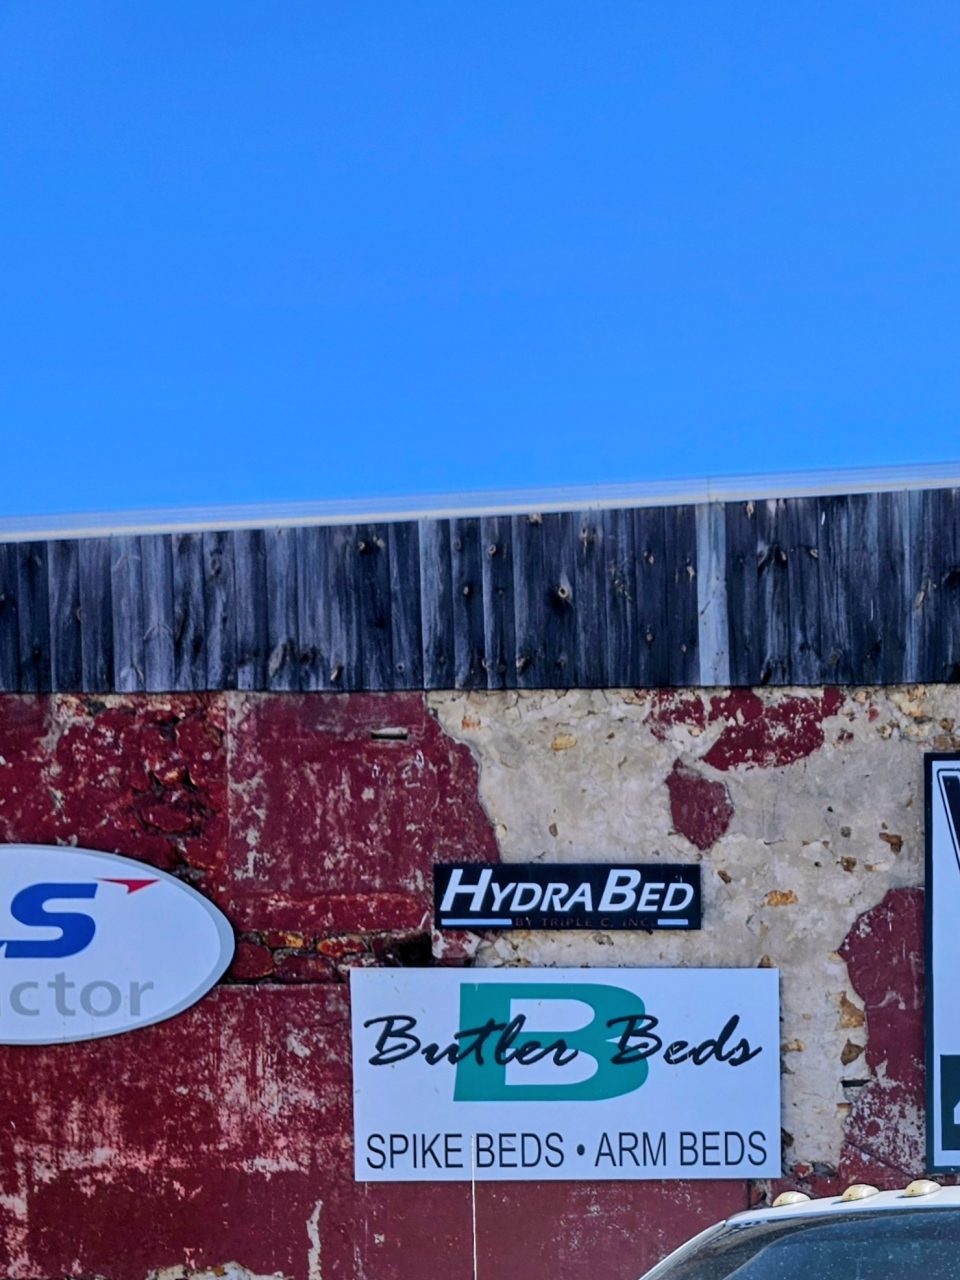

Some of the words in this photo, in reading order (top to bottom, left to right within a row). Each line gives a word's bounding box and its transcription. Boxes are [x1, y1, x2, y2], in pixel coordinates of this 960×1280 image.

[0, 882, 98, 958] S
[542, 918, 592, 927] TRIPLE
[0, 972, 154, 1017] ctor
[363, 1013, 578, 1066] Butler
[606, 1013, 763, 1066] Beds
[366, 1133, 463, 1169] SPIKE
[475, 1132, 565, 1168] BEDS
[595, 1131, 668, 1166] ARM
[680, 1130, 768, 1166] BEDS
